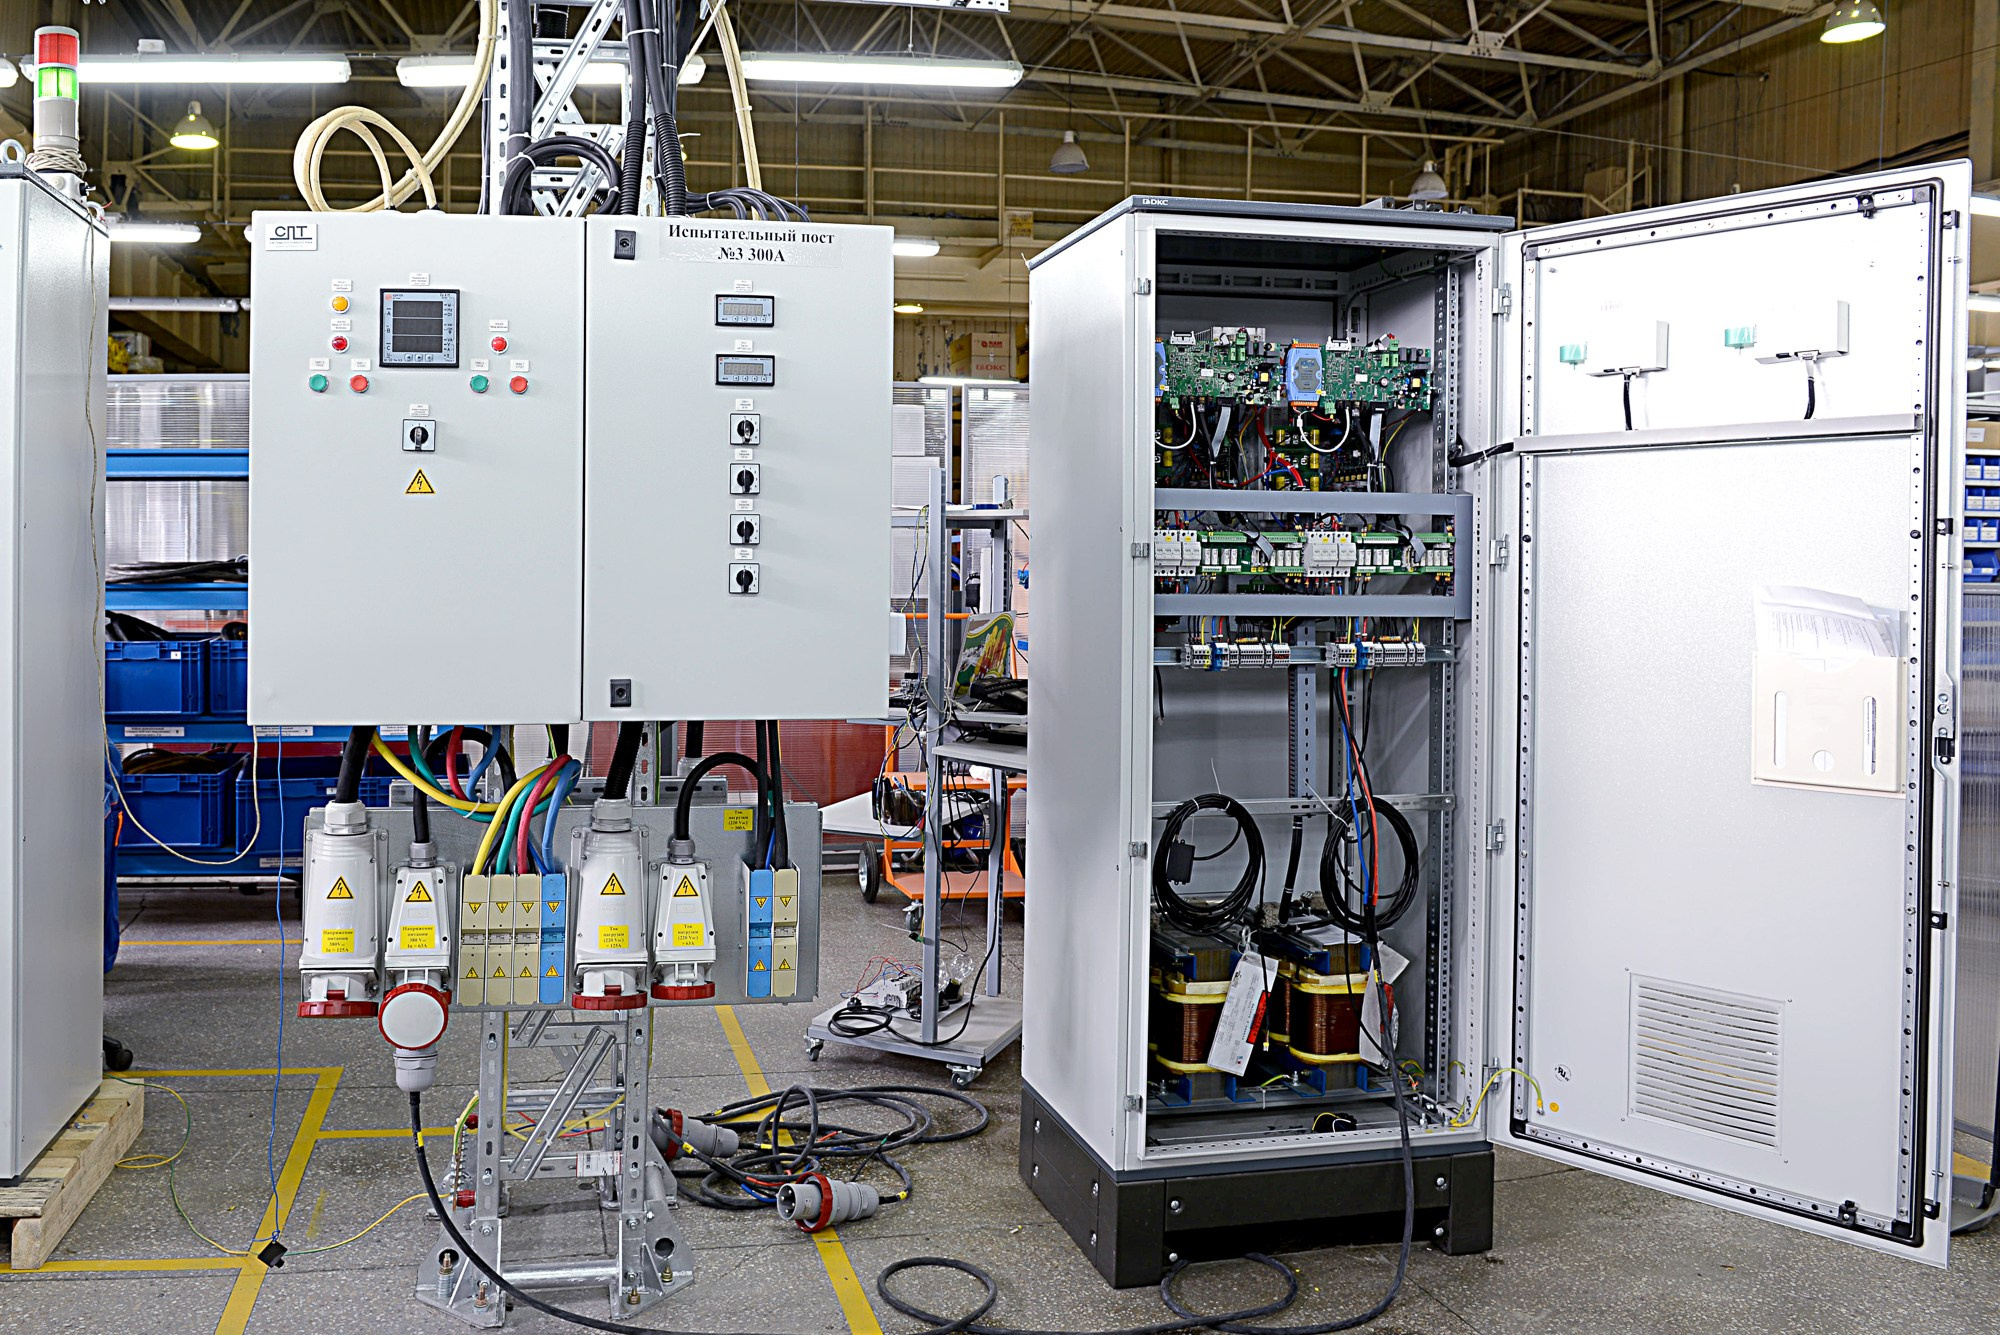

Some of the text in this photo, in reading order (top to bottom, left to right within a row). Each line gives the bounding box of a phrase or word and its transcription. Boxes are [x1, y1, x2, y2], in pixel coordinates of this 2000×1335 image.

[669, 224, 835, 243] Испытательный пост
[718, 247, 785, 262] №3 300А
